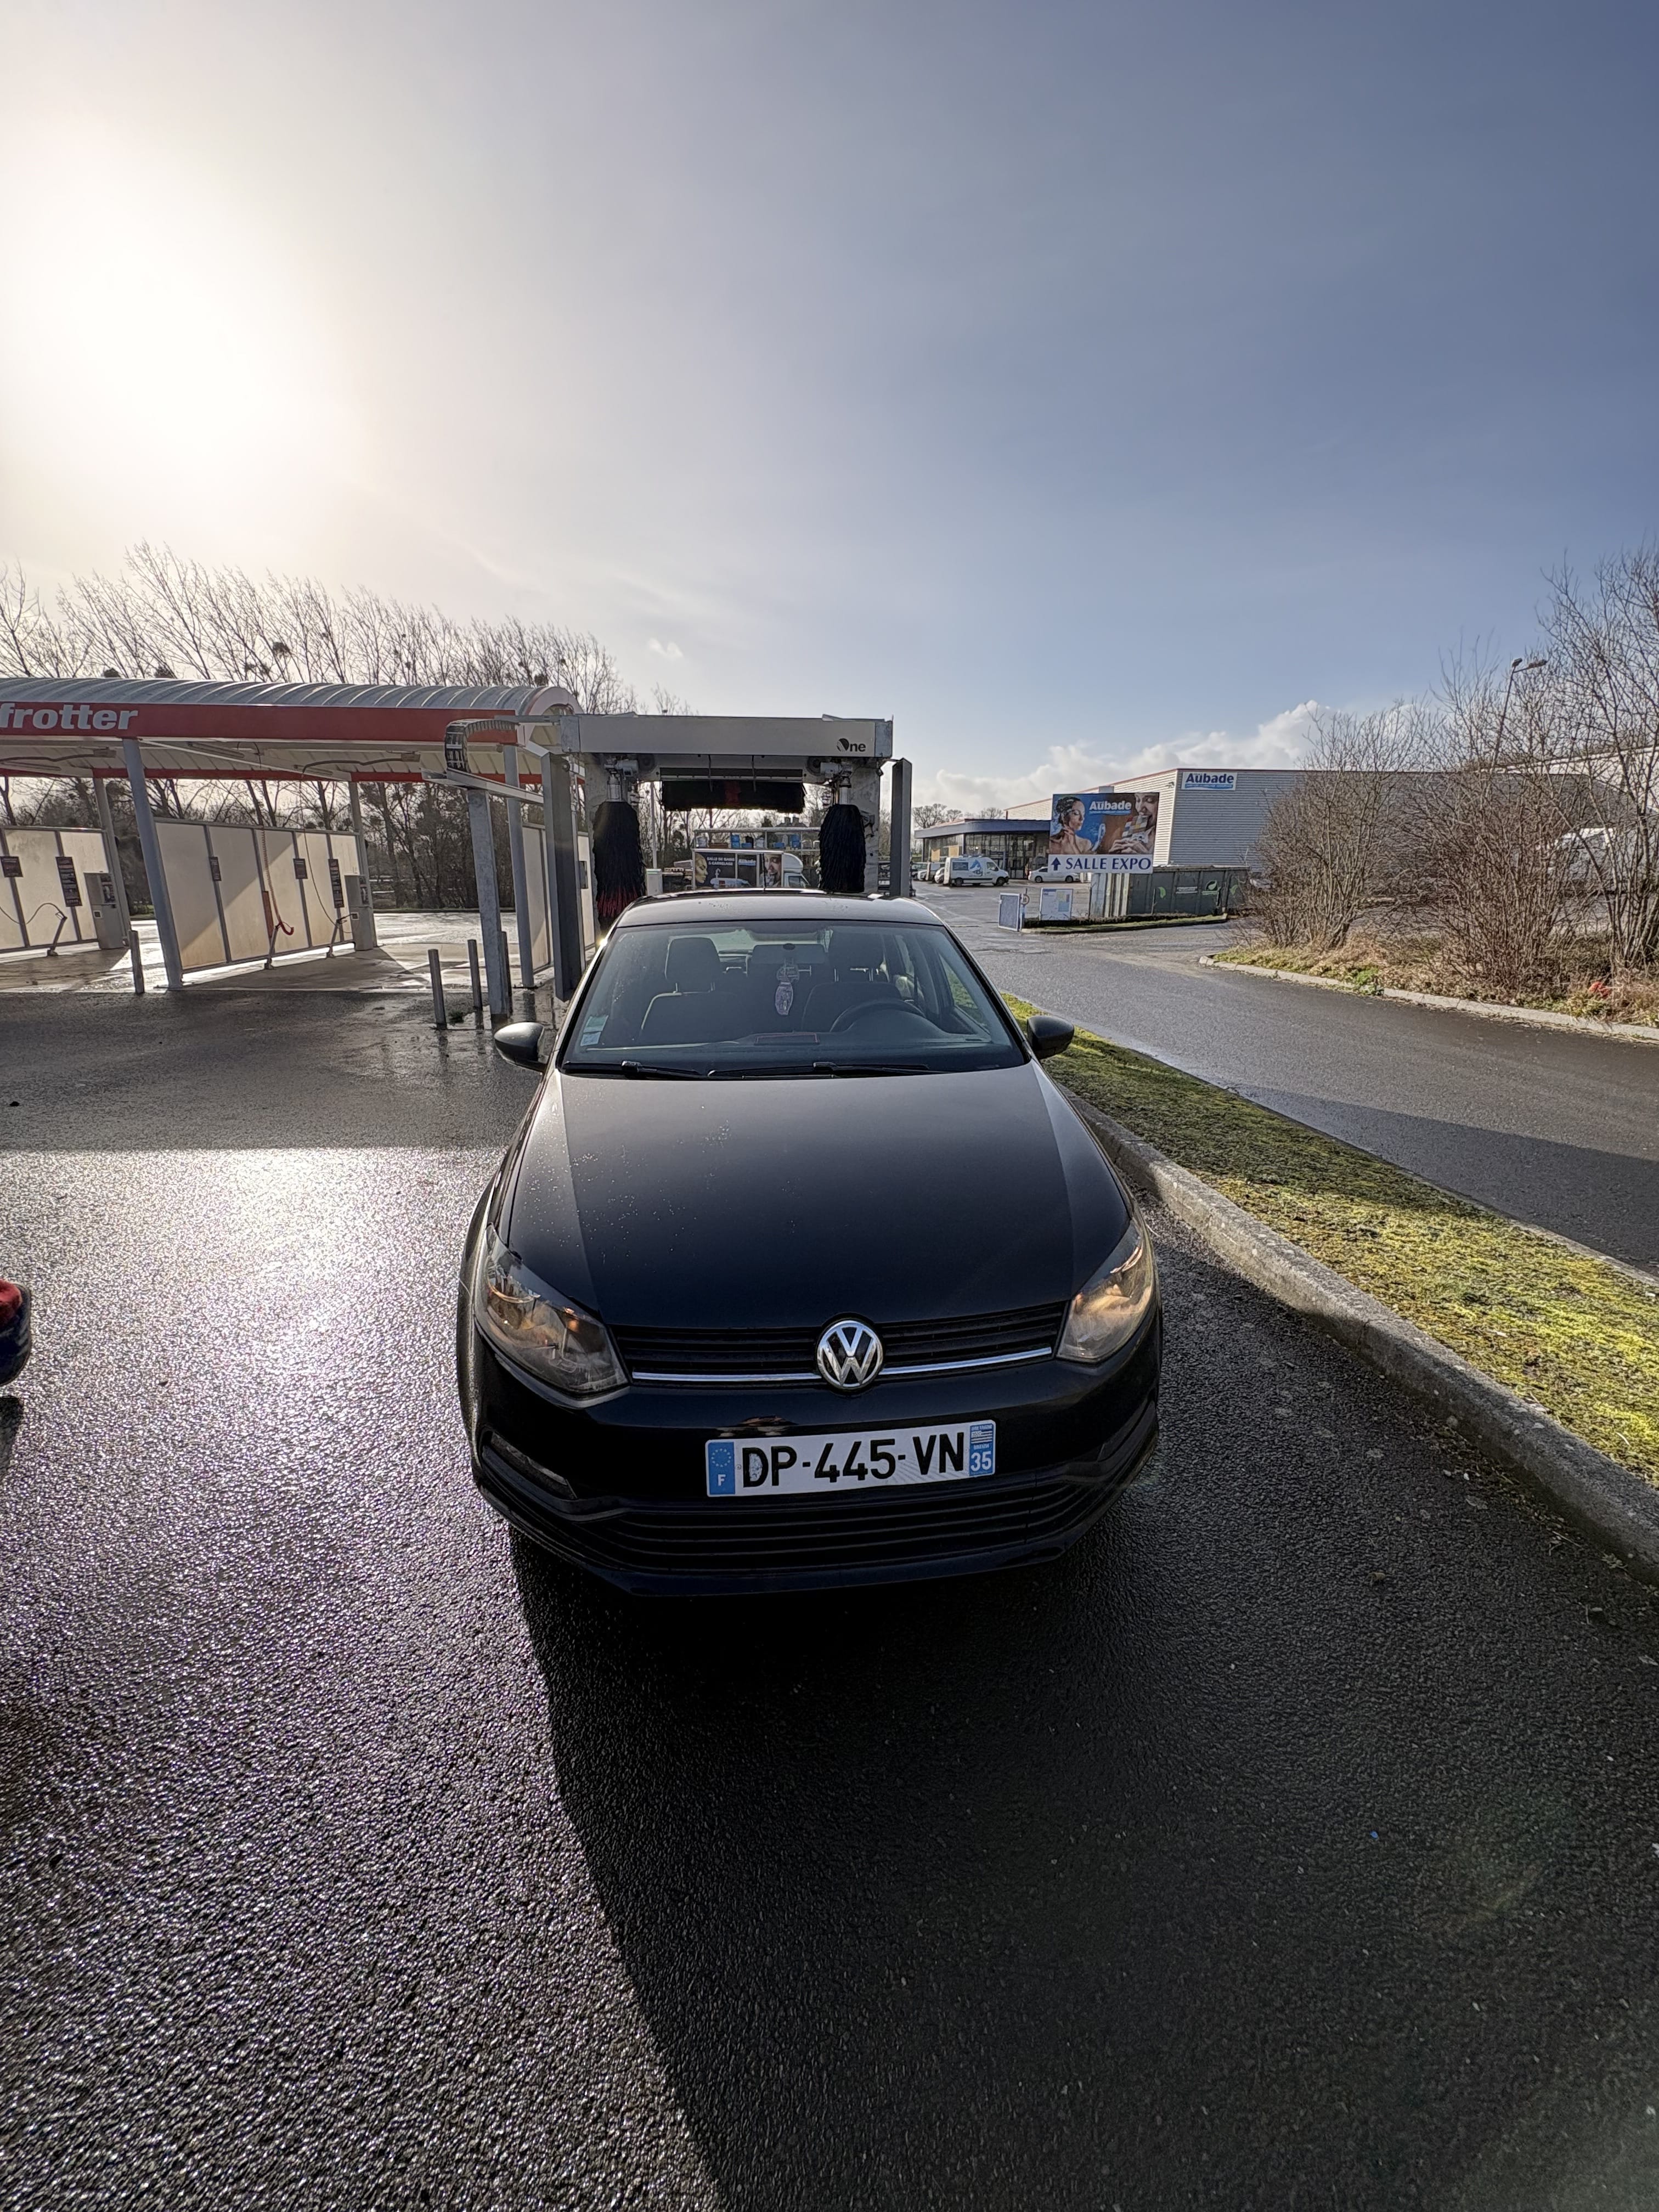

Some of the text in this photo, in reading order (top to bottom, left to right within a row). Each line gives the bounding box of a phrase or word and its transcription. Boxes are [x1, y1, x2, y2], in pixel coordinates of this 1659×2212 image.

[1186, 773, 1234, 783] Aubade
[1089, 800, 1132, 810] Aubade
[1065, 857, 1151, 870] SALLE EXPO
[742, 1432, 964, 1488] DP-445-VN
[970, 1451, 991, 1471] 35
[718, 1474, 726, 1486] F
